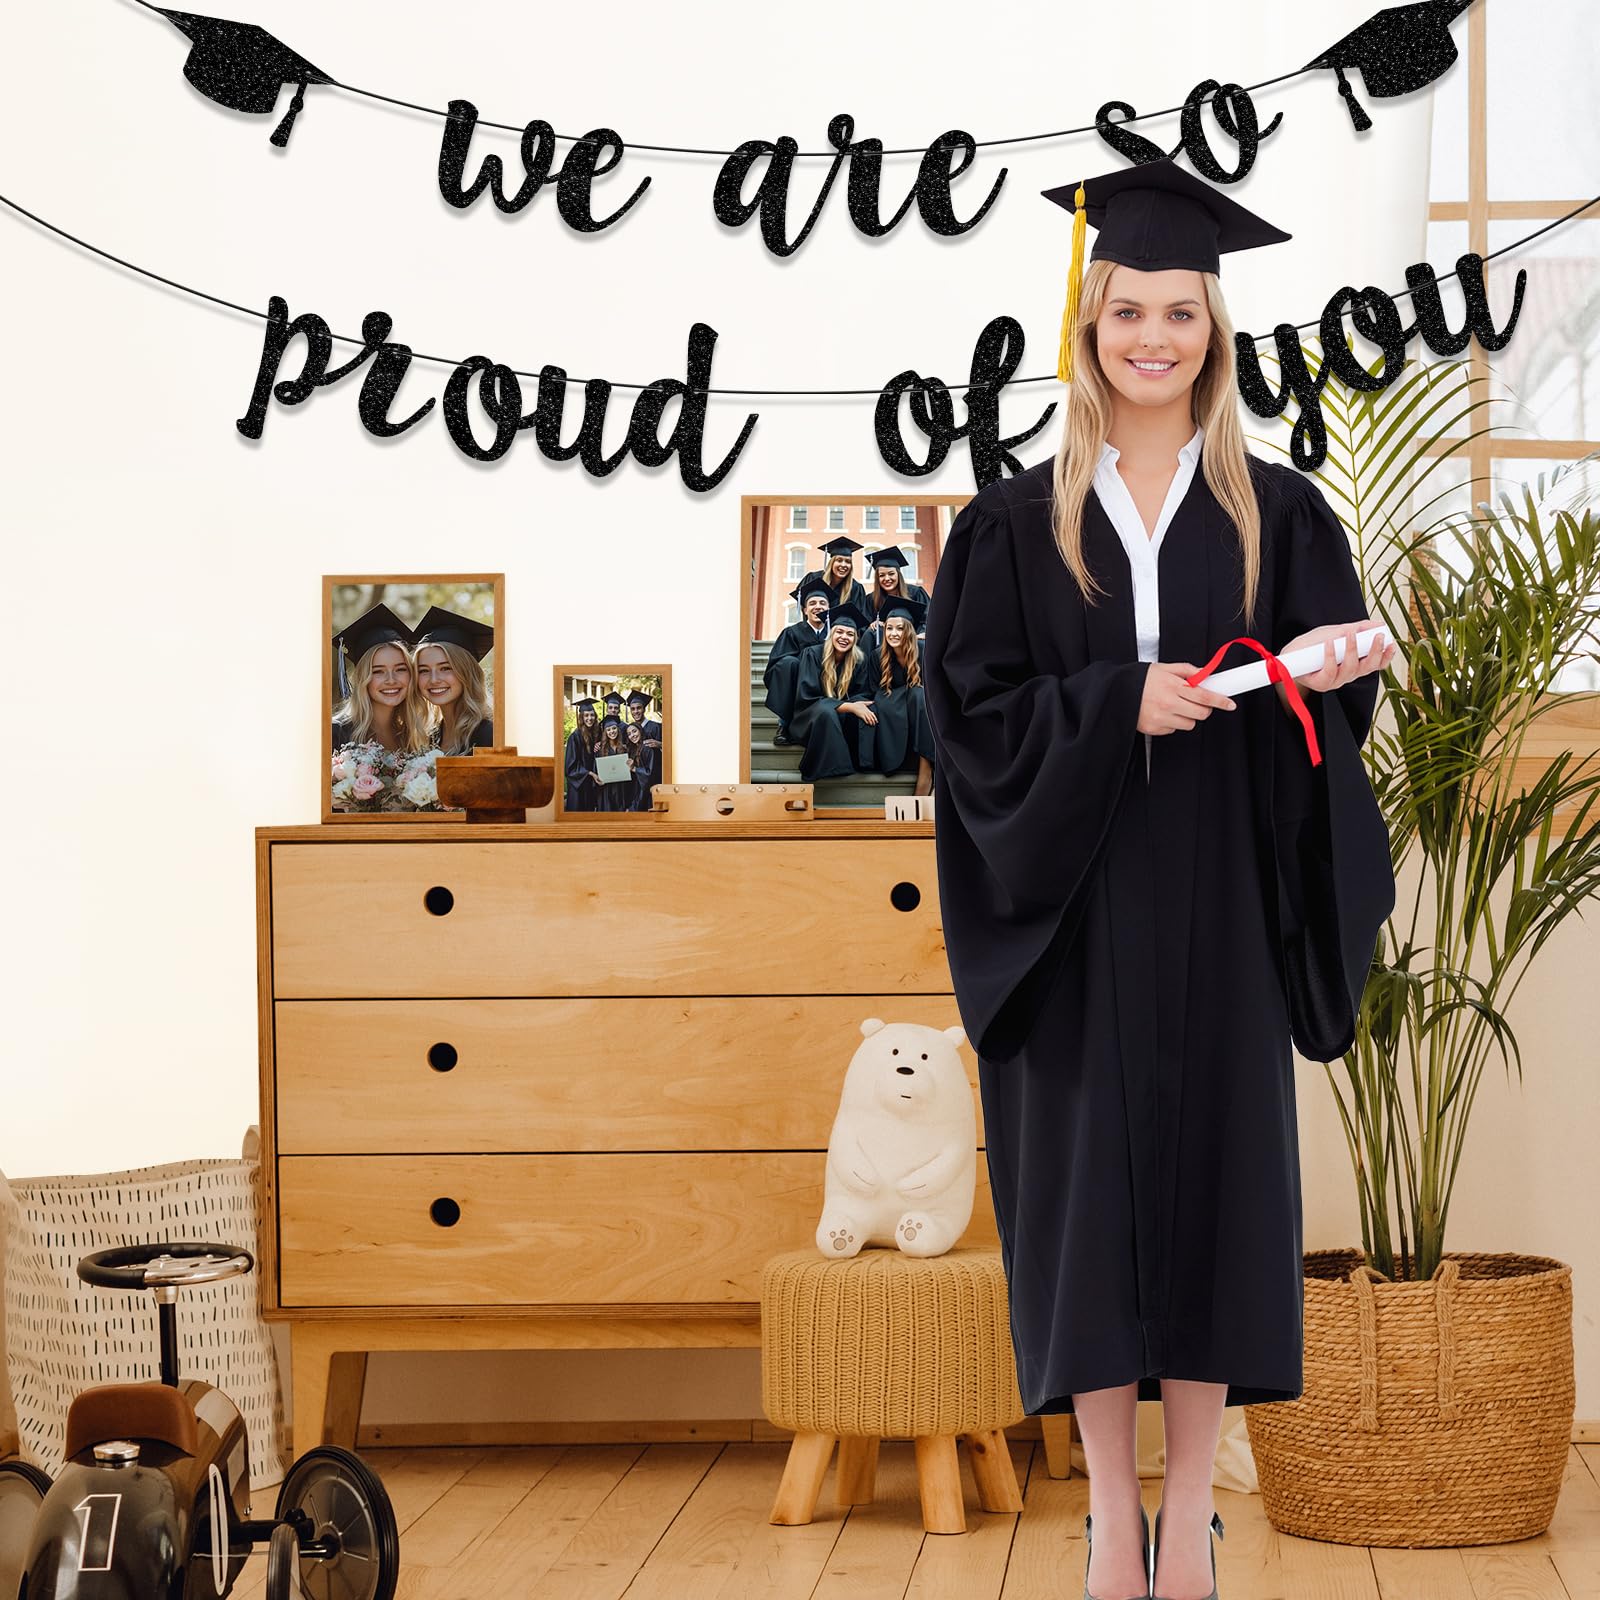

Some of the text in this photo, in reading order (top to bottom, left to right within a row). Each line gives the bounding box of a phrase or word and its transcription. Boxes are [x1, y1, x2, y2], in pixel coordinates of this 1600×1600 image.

[438, 99, 652, 233] we
[713, 113, 1008, 258] are
[236, 253, 1527, 493] proud of you
[75, 1494, 121, 1571] 1
